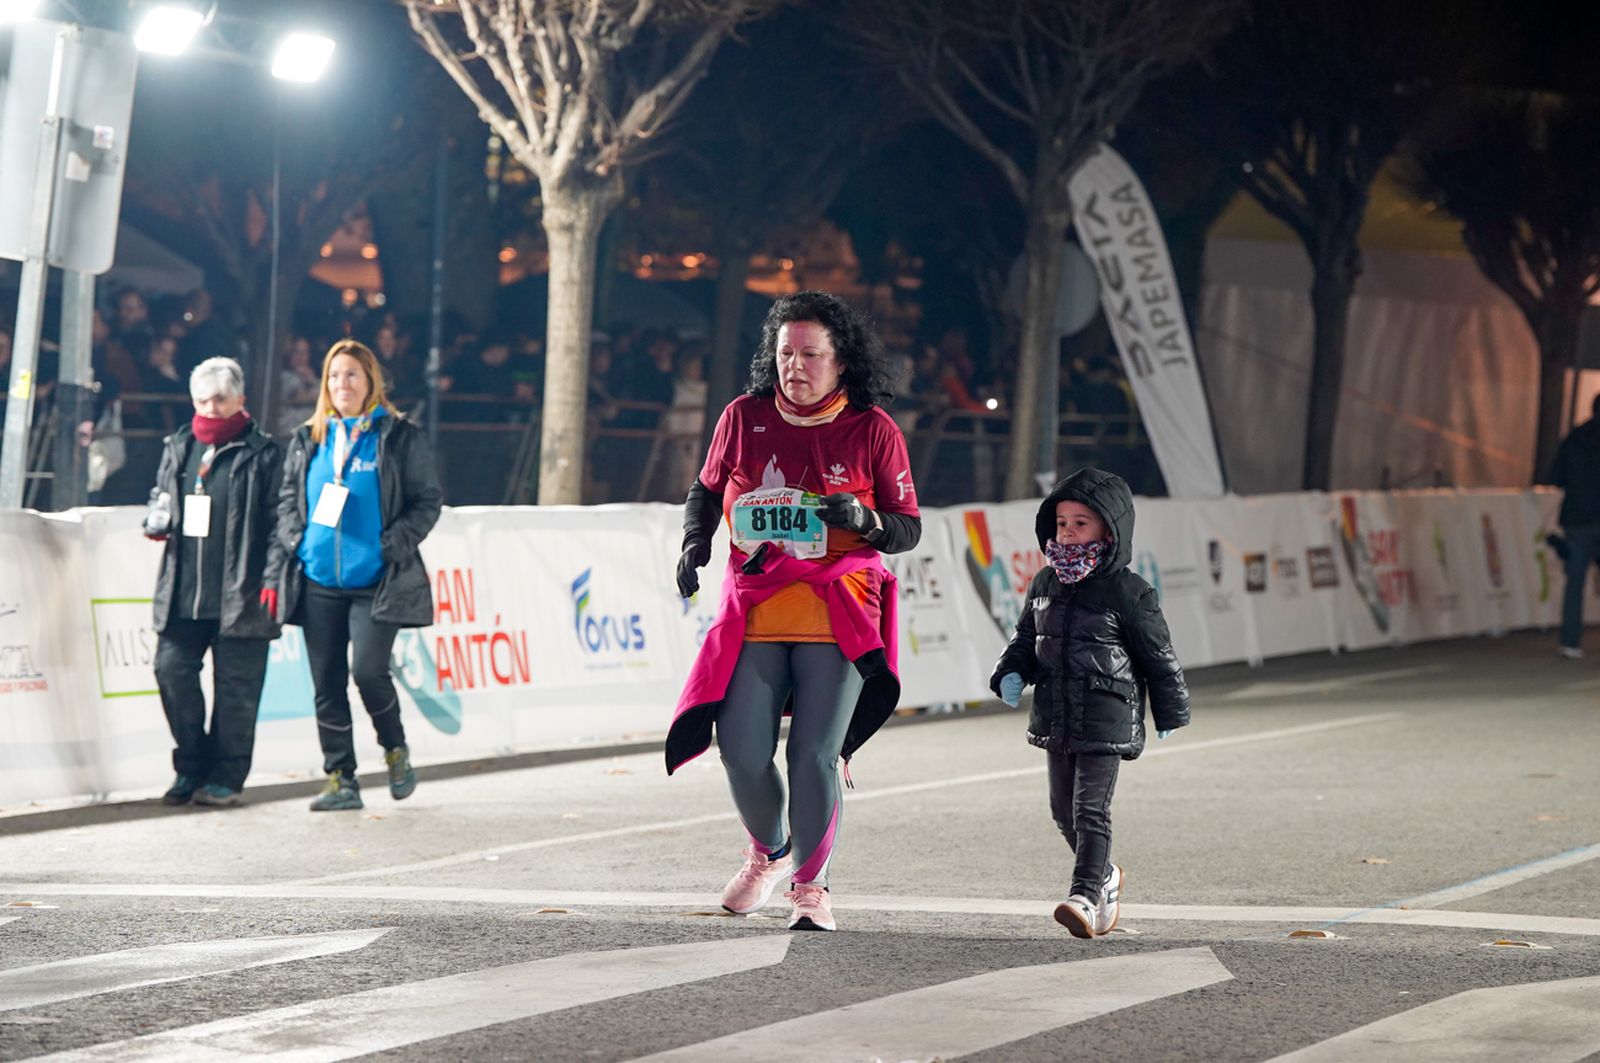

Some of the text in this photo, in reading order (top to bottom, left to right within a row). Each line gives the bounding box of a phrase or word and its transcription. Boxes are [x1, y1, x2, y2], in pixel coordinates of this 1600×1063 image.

[1109, 181, 1189, 367] JAPEMASA
[751, 506, 808, 532] 8184
[430, 567, 476, 624] AN
[435, 613, 531, 692] ANTÓN
